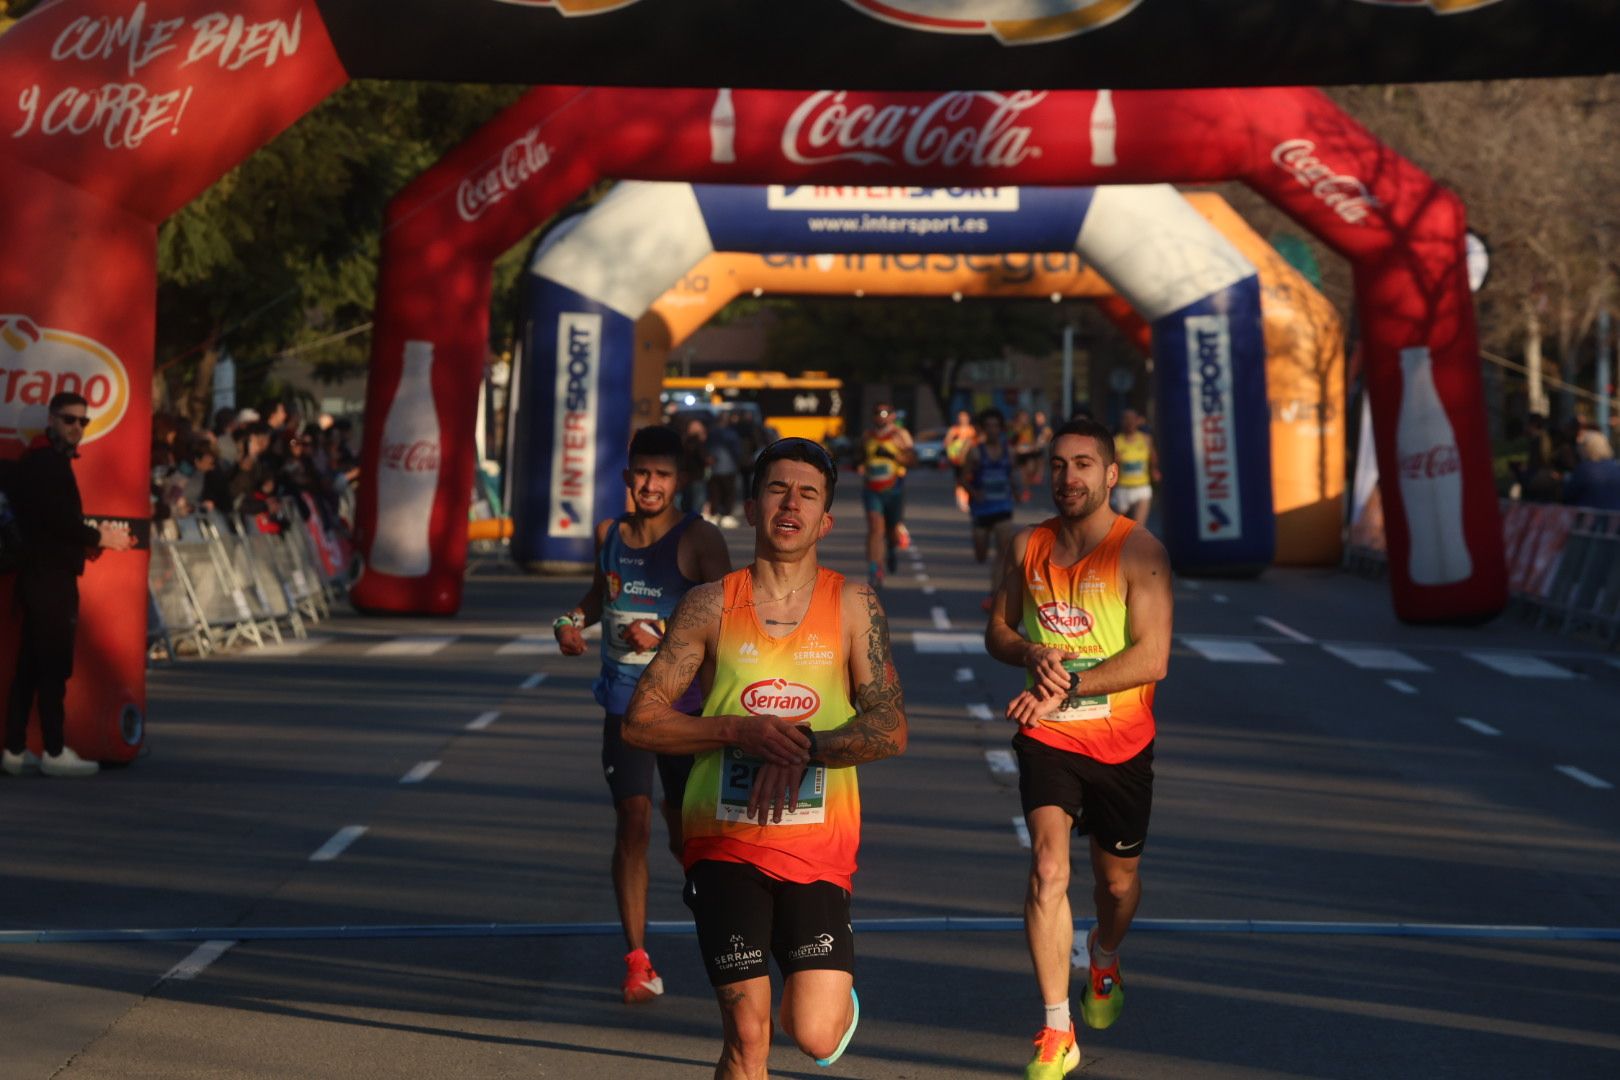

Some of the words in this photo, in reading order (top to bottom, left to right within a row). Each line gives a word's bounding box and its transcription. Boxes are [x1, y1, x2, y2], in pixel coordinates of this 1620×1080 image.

[51, 1, 184, 77] COME
[178, 9, 302, 71] BIEN
[41, 83, 193, 149] CORRE!
[781, 90, 1049, 167] Coca-Cola
[808, 214, 988, 235] www.intersport.es
[0, 367, 111, 409] rano
[561, 325, 590, 497] INTERSPORT
[1197, 330, 1230, 500] INTERSPORT
[624, 582, 663, 598] Carnes
[793, 651, 834, 660] SERRANO
[747, 689, 814, 710] Serrano
[714, 949, 762, 965] SERRANO
